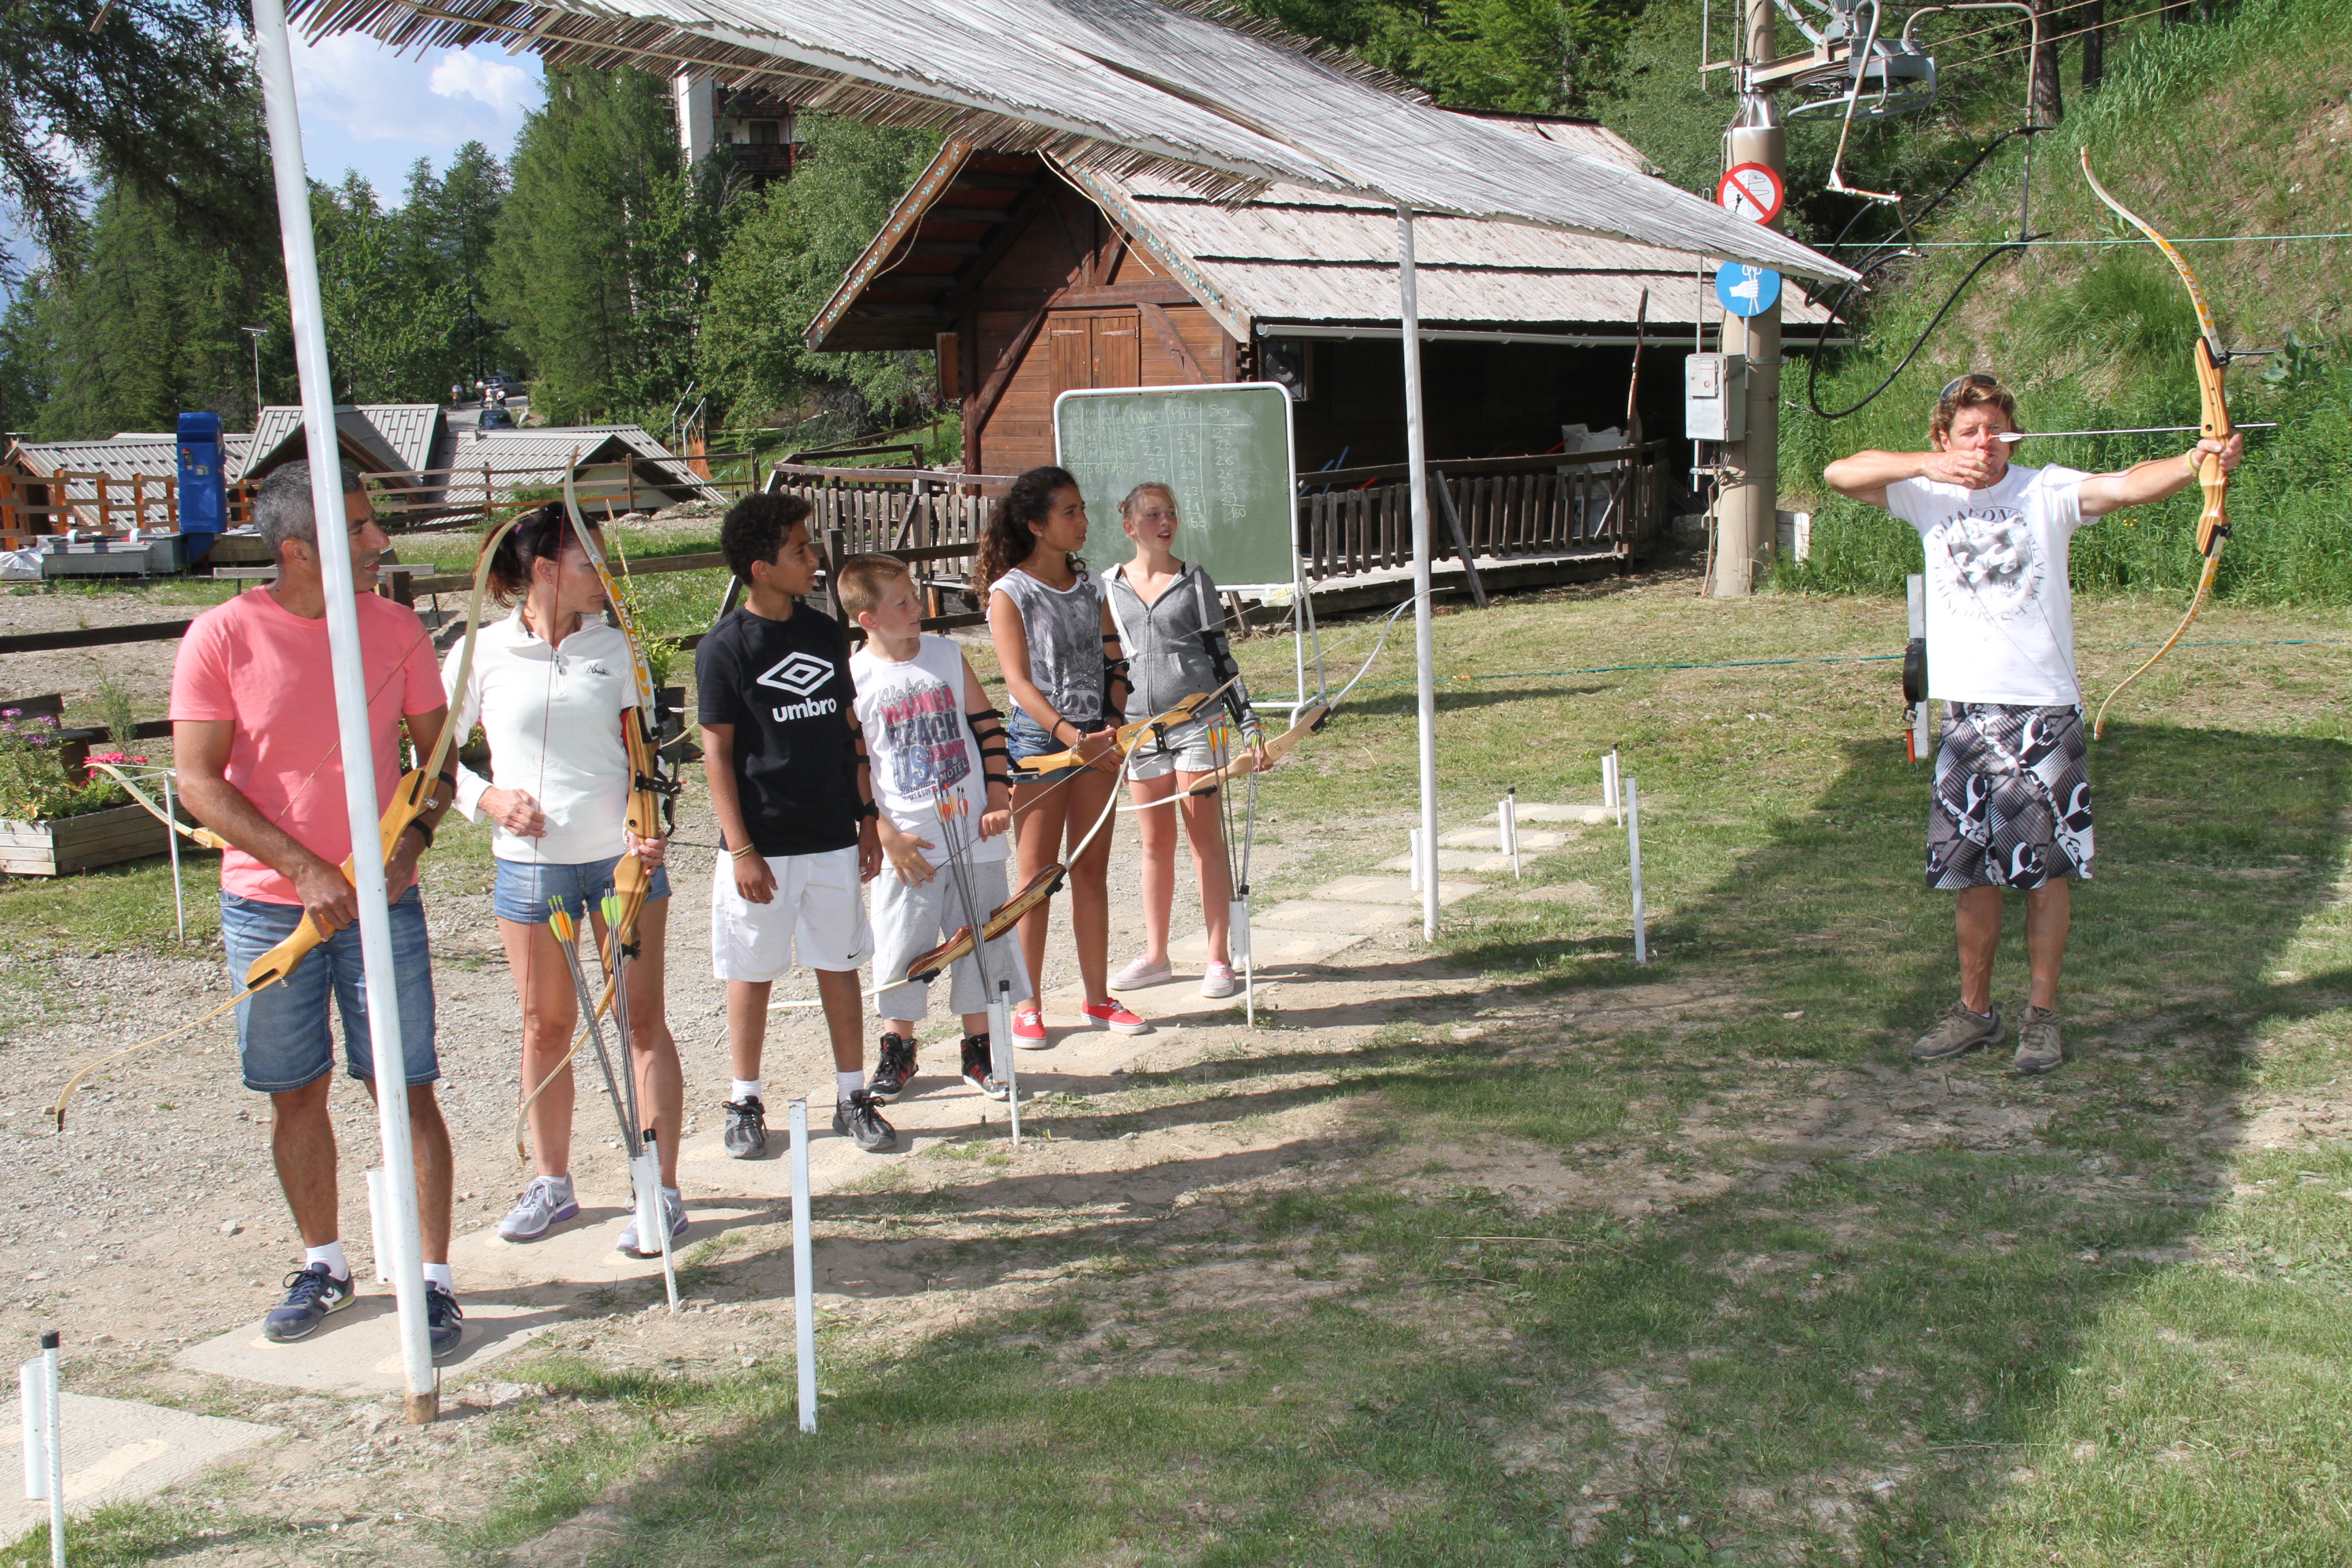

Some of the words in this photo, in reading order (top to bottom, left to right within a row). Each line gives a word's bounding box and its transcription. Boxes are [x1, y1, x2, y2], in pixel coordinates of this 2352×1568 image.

[2167, 249, 2188, 272] ONE
[2185, 274, 2204, 304] STEP
[1171, 406, 1194, 420] PAT
[1139, 429, 1161, 442] 25
[1177, 428, 1194, 441] 24
[1212, 427, 1232, 439] 27
[1144, 445, 1166, 457] 22
[1148, 458, 1166, 470] 27
[1180, 454, 1194, 468] 24
[1215, 455, 1234, 466] 26
[1217, 469, 1235, 479] 26
[1184, 485, 1198, 496] 23
[1219, 481, 1235, 491] 26
[1185, 499, 1200, 510] 21
[1221, 492, 1238, 503] 27
[1227, 506, 1246, 519] 160
[2193, 587, 2208, 612] ONE
[616, 598, 634, 630] ONE
[630, 632, 645, 668] STEP
[877, 677, 928, 710] Aloha
[772, 698, 837, 722] umbro
[881, 686, 956, 726] WAIMEA
[889, 710, 961, 747] BEACH
[939, 759, 968, 782] MOTEL
[898, 779, 937, 796] Hawaiian
[921, 785, 938, 796] SOFS
